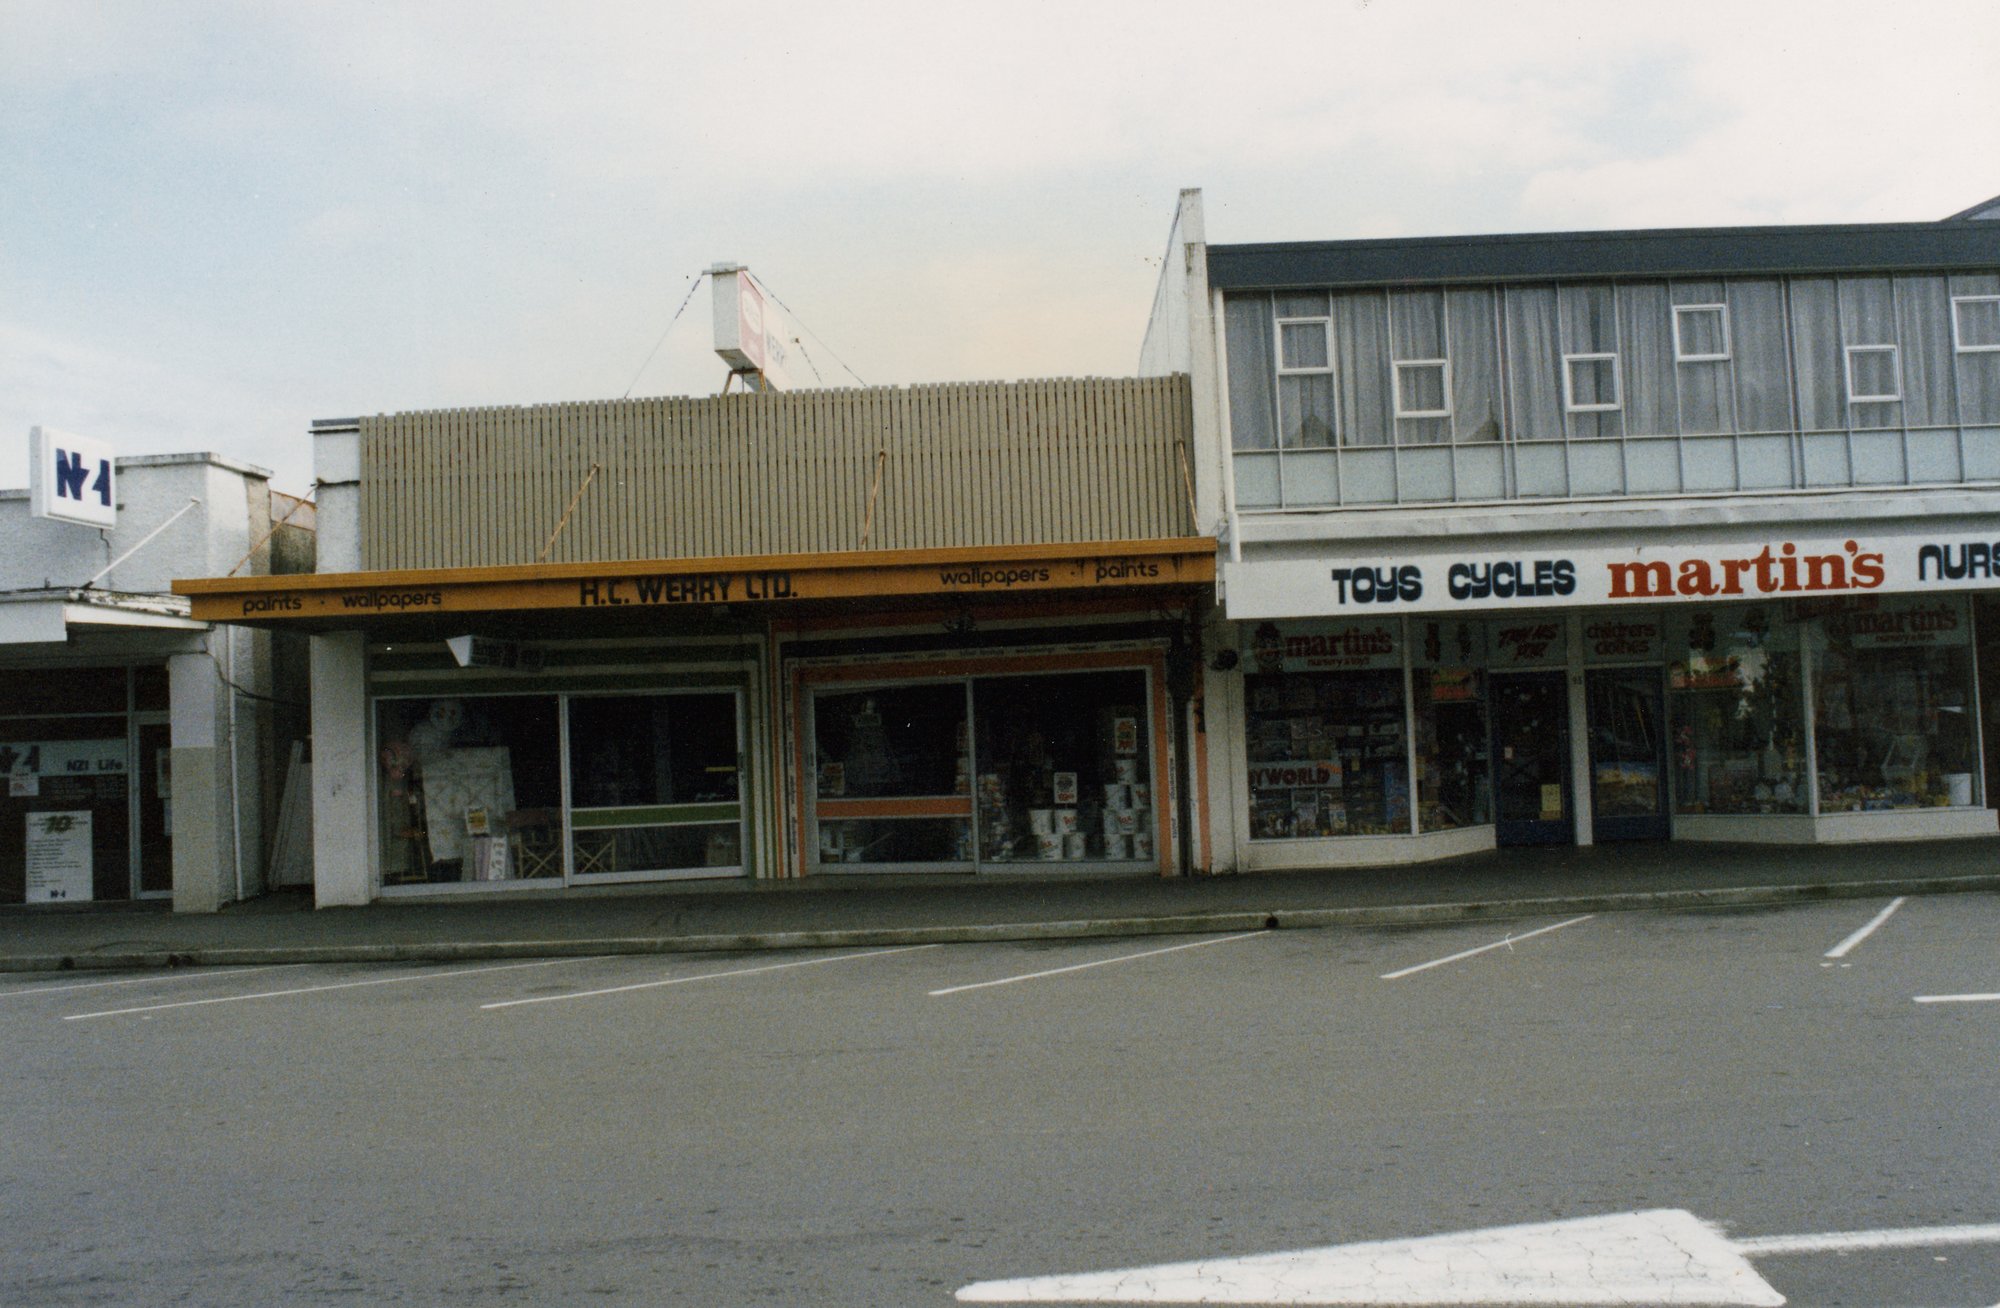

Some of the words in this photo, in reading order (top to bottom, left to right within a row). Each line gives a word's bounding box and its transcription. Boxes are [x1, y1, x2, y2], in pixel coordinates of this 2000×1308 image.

[940, 566, 1050, 588] wallpapers
[1096, 560, 1159, 583] paints
[1332, 565, 1422, 604] TOYS
[1448, 559, 1576, 600] CYCLES
[1607, 540, 1885, 598] martin's
[634, 572, 732, 604] WERRY
[745, 571, 798, 600] LTD.
[243, 595, 302, 616] paints
[342, 590, 441, 611] wallpapers
[1284, 627, 1392, 658] martin's
[98, 759, 123, 770] Life
